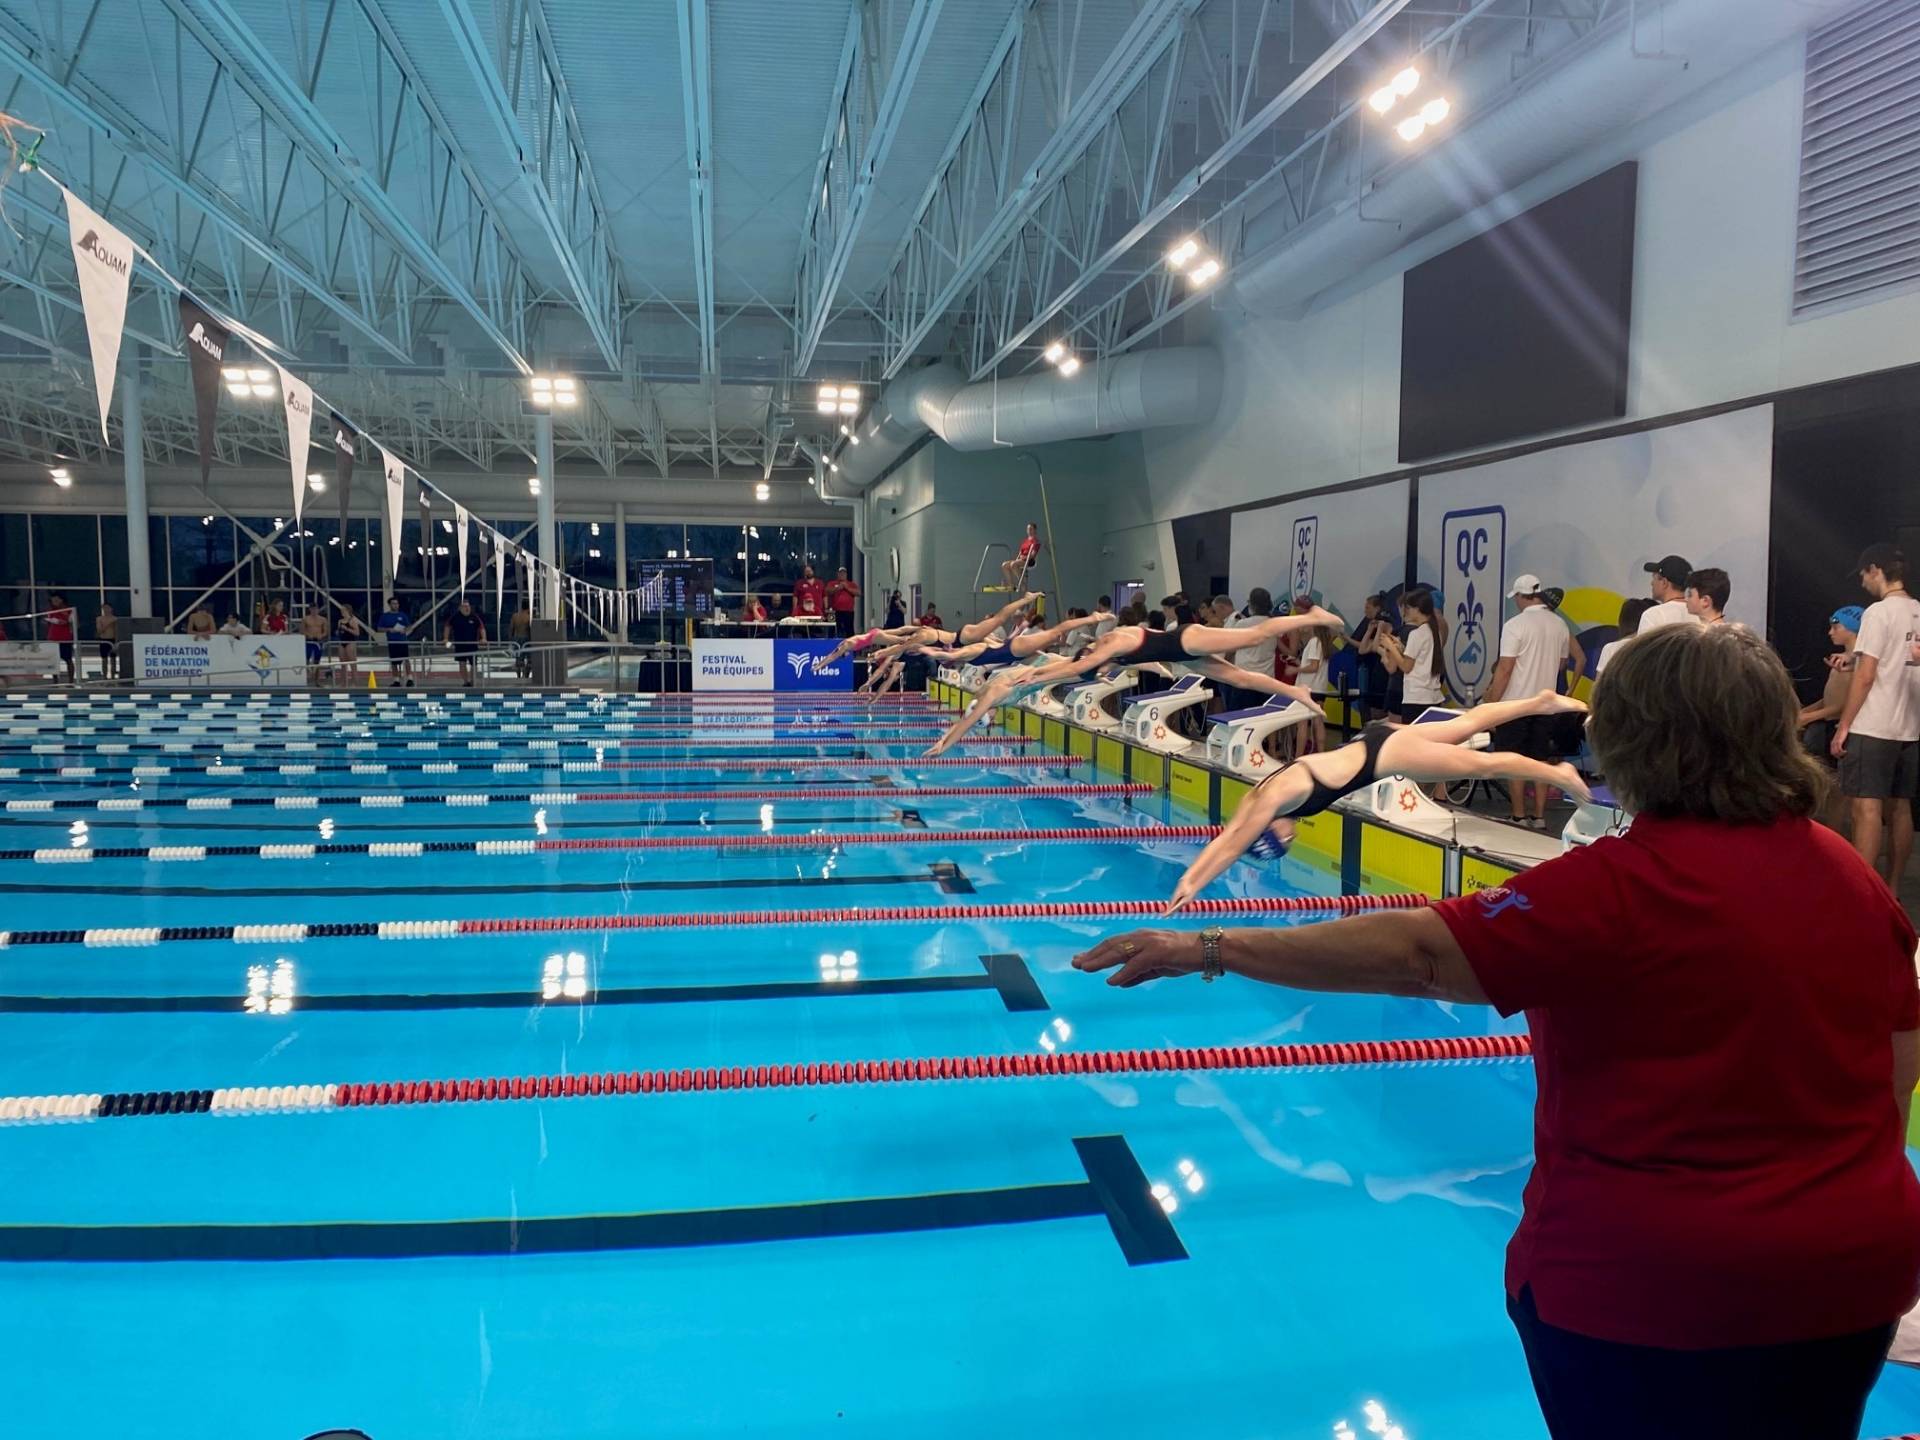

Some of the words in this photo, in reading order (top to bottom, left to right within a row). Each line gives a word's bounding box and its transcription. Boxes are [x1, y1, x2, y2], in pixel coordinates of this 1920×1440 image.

[77, 229, 127, 277] AQUAM
[188, 322, 222, 361] AQUAM
[1298, 526, 1312, 549] QC
[1456, 527, 1489, 578] QC
[145, 644, 208, 656] FÉDÉRATION
[145, 657, 159, 667] DE
[161, 657, 210, 667] NATATION
[702, 655, 746, 664] FESTIVAL
[145, 668, 160, 678] DU
[162, 667, 202, 678] QUÉBEC
[702, 666, 721, 676] PAR
[723, 664, 764, 676] ÉQUIPES
[1084, 692, 1093, 705] 5
[1149, 707, 1159, 721] 6
[1243, 728, 1255, 744] 7
